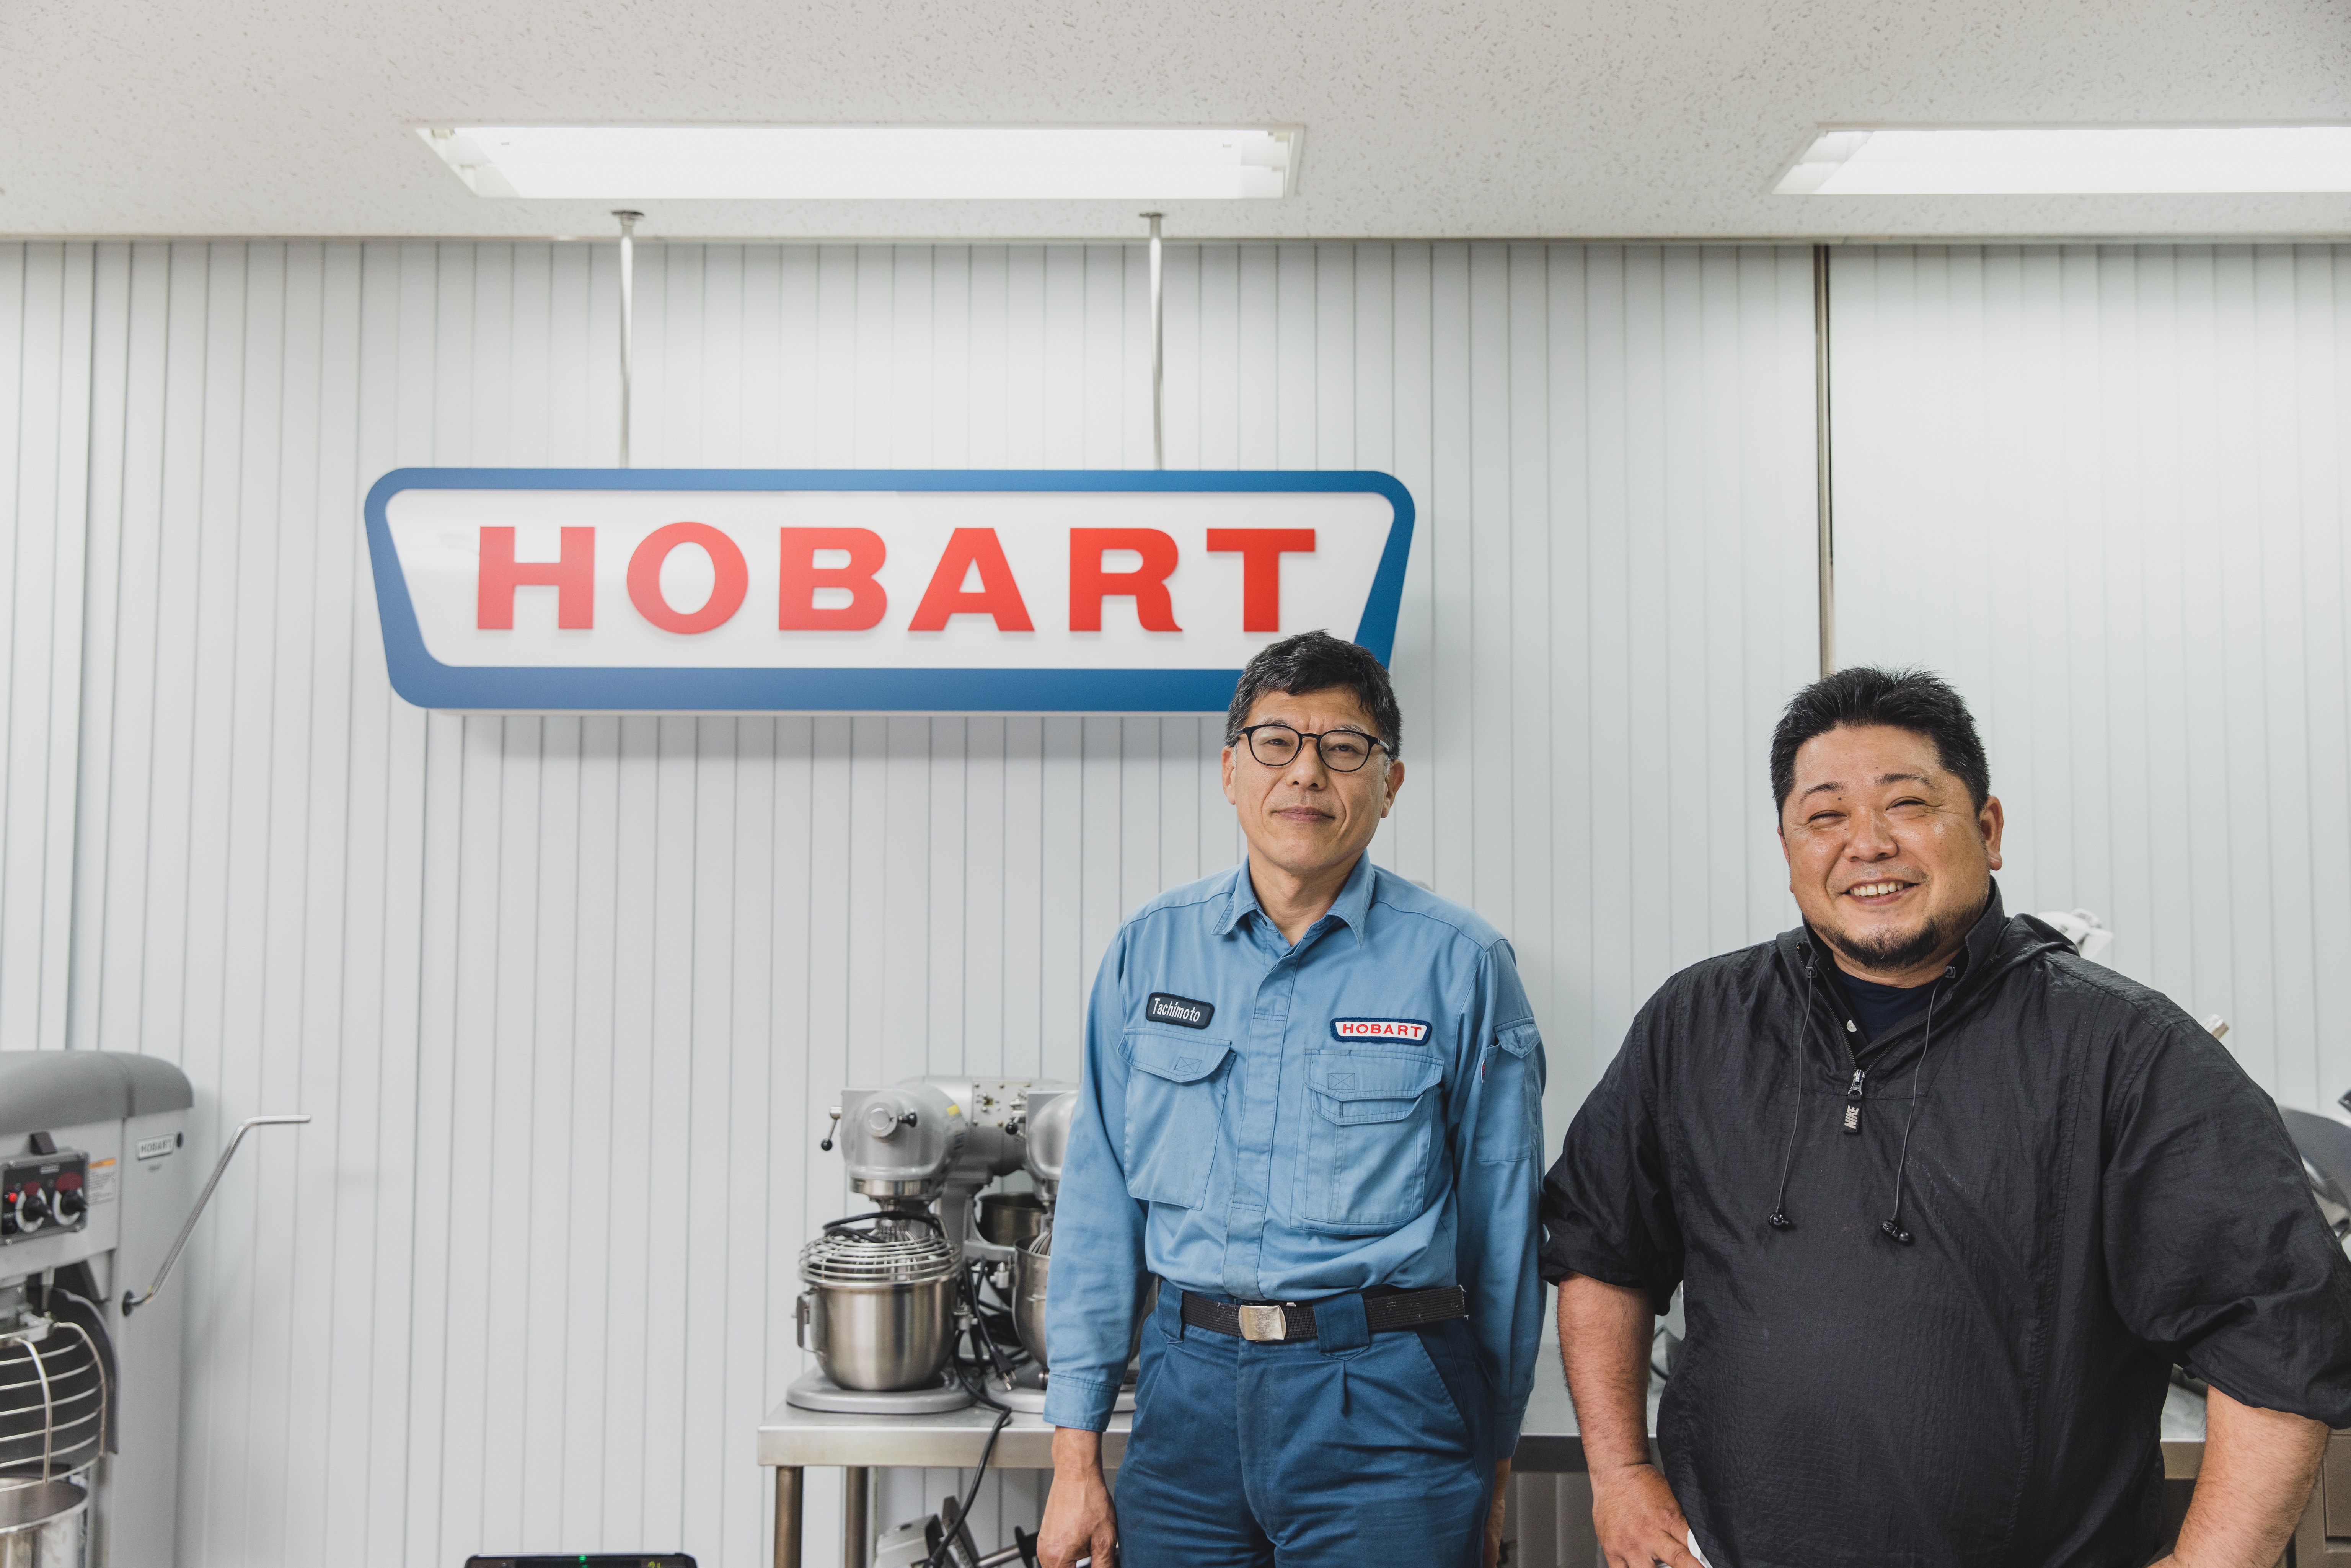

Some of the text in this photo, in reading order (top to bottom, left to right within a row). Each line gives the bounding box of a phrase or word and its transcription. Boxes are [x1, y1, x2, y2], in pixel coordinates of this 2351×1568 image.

[477, 521, 1316, 635] HOBART
[1153, 998, 1201, 1022] Tachimoto
[1342, 1024, 1422, 1037] HOBART
[1844, 1105, 1859, 1129] NIKE
[141, 1139, 172, 1153] HOBART
